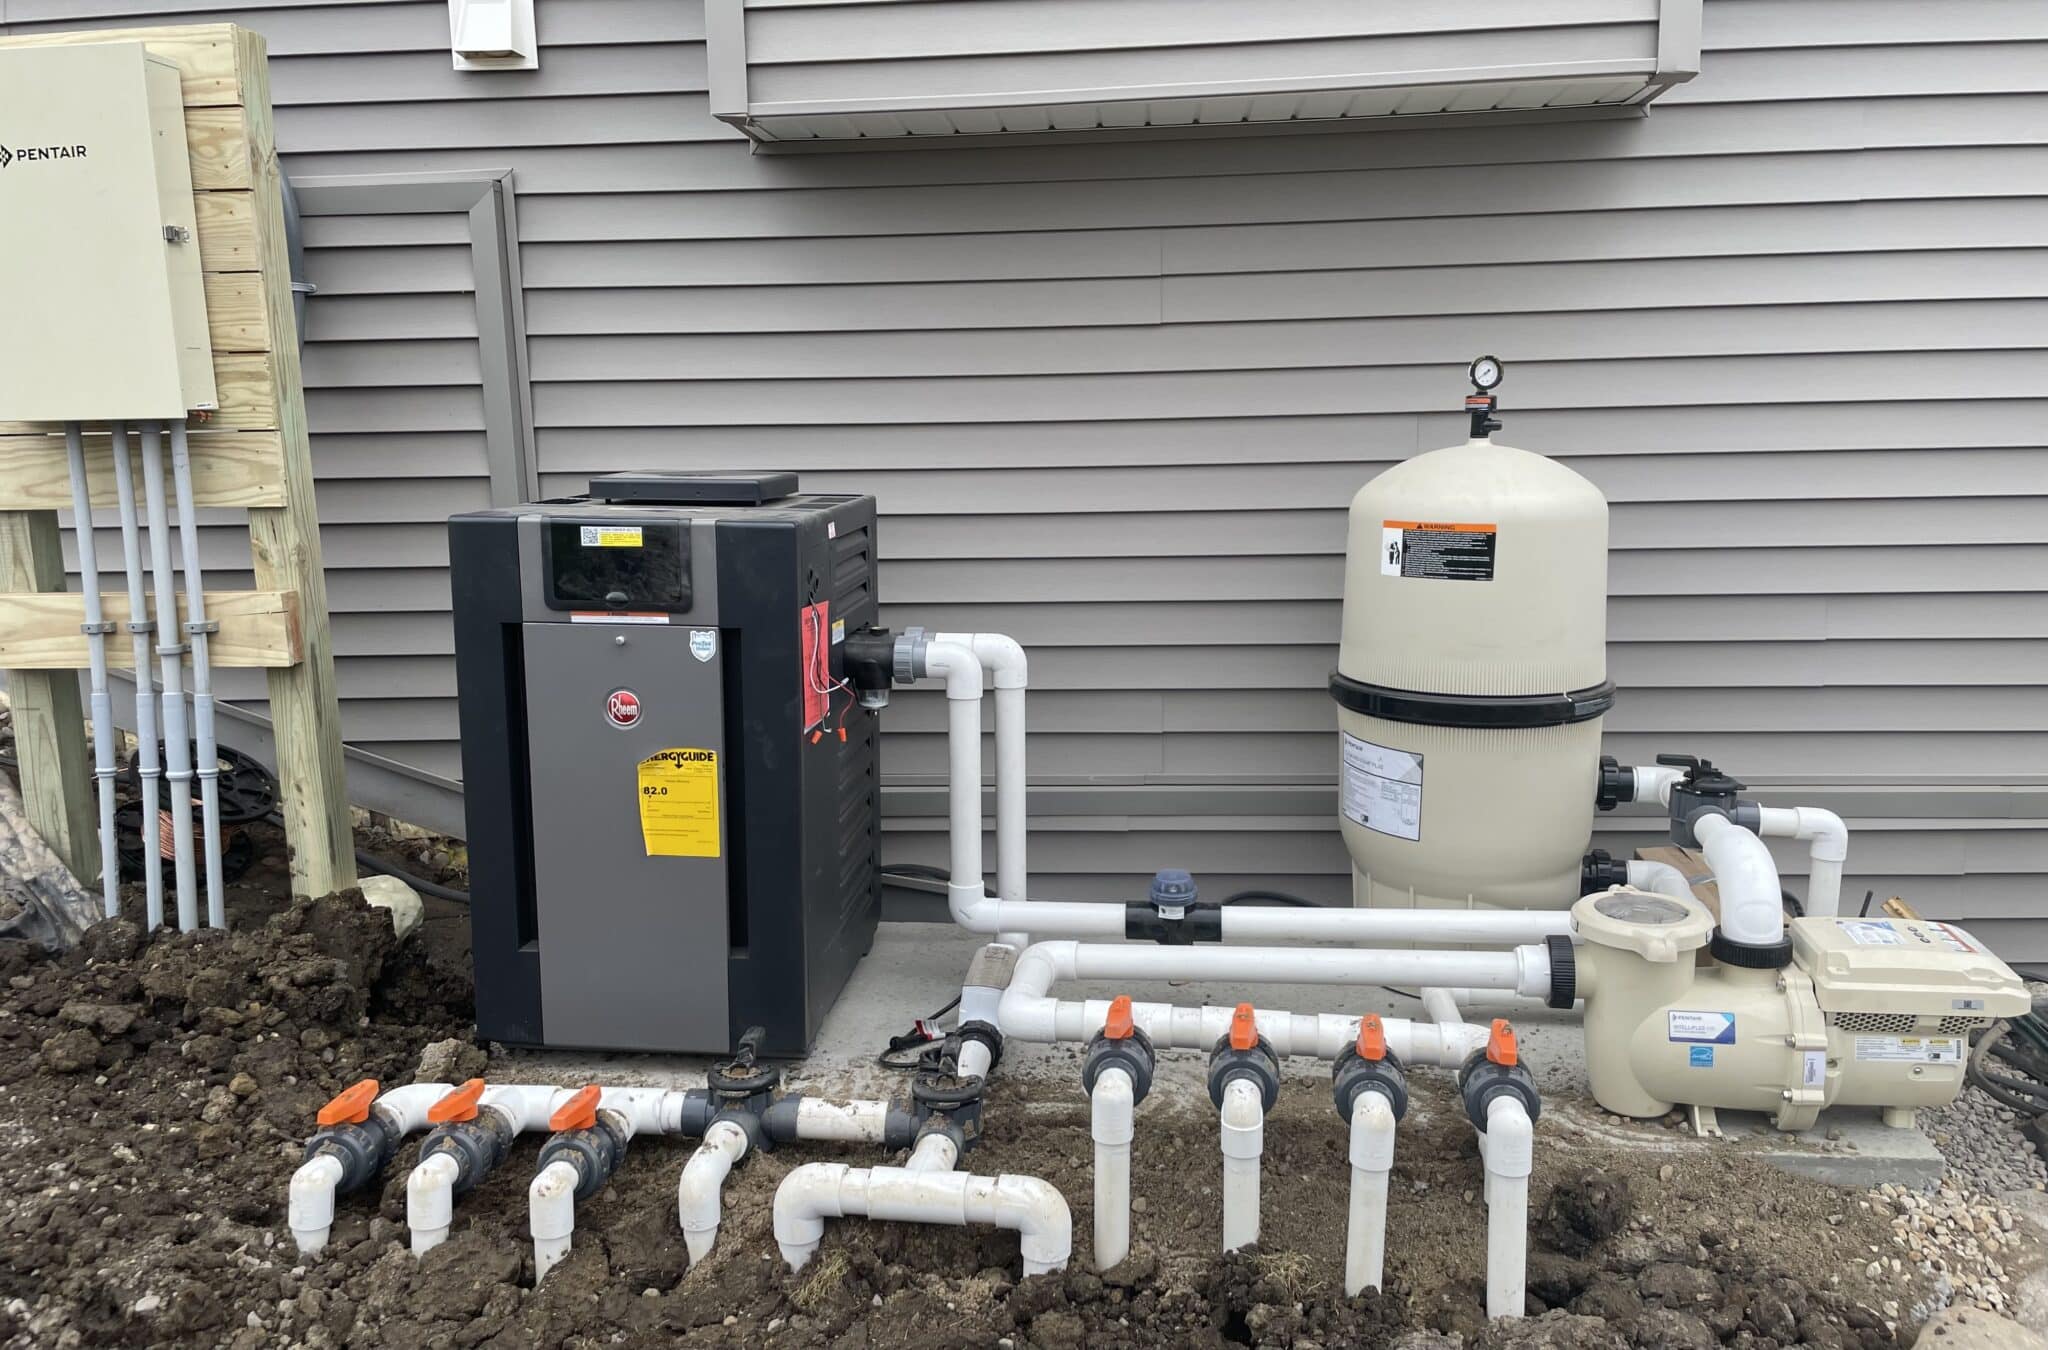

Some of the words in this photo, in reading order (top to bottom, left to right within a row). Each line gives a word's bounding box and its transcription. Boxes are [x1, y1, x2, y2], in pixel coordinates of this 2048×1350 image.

[16, 145, 87, 161] PENTAIR
[610, 694, 638, 719] Rheem
[643, 751, 714, 764] ERGYGUIDE
[643, 786, 668, 795] 82.0
